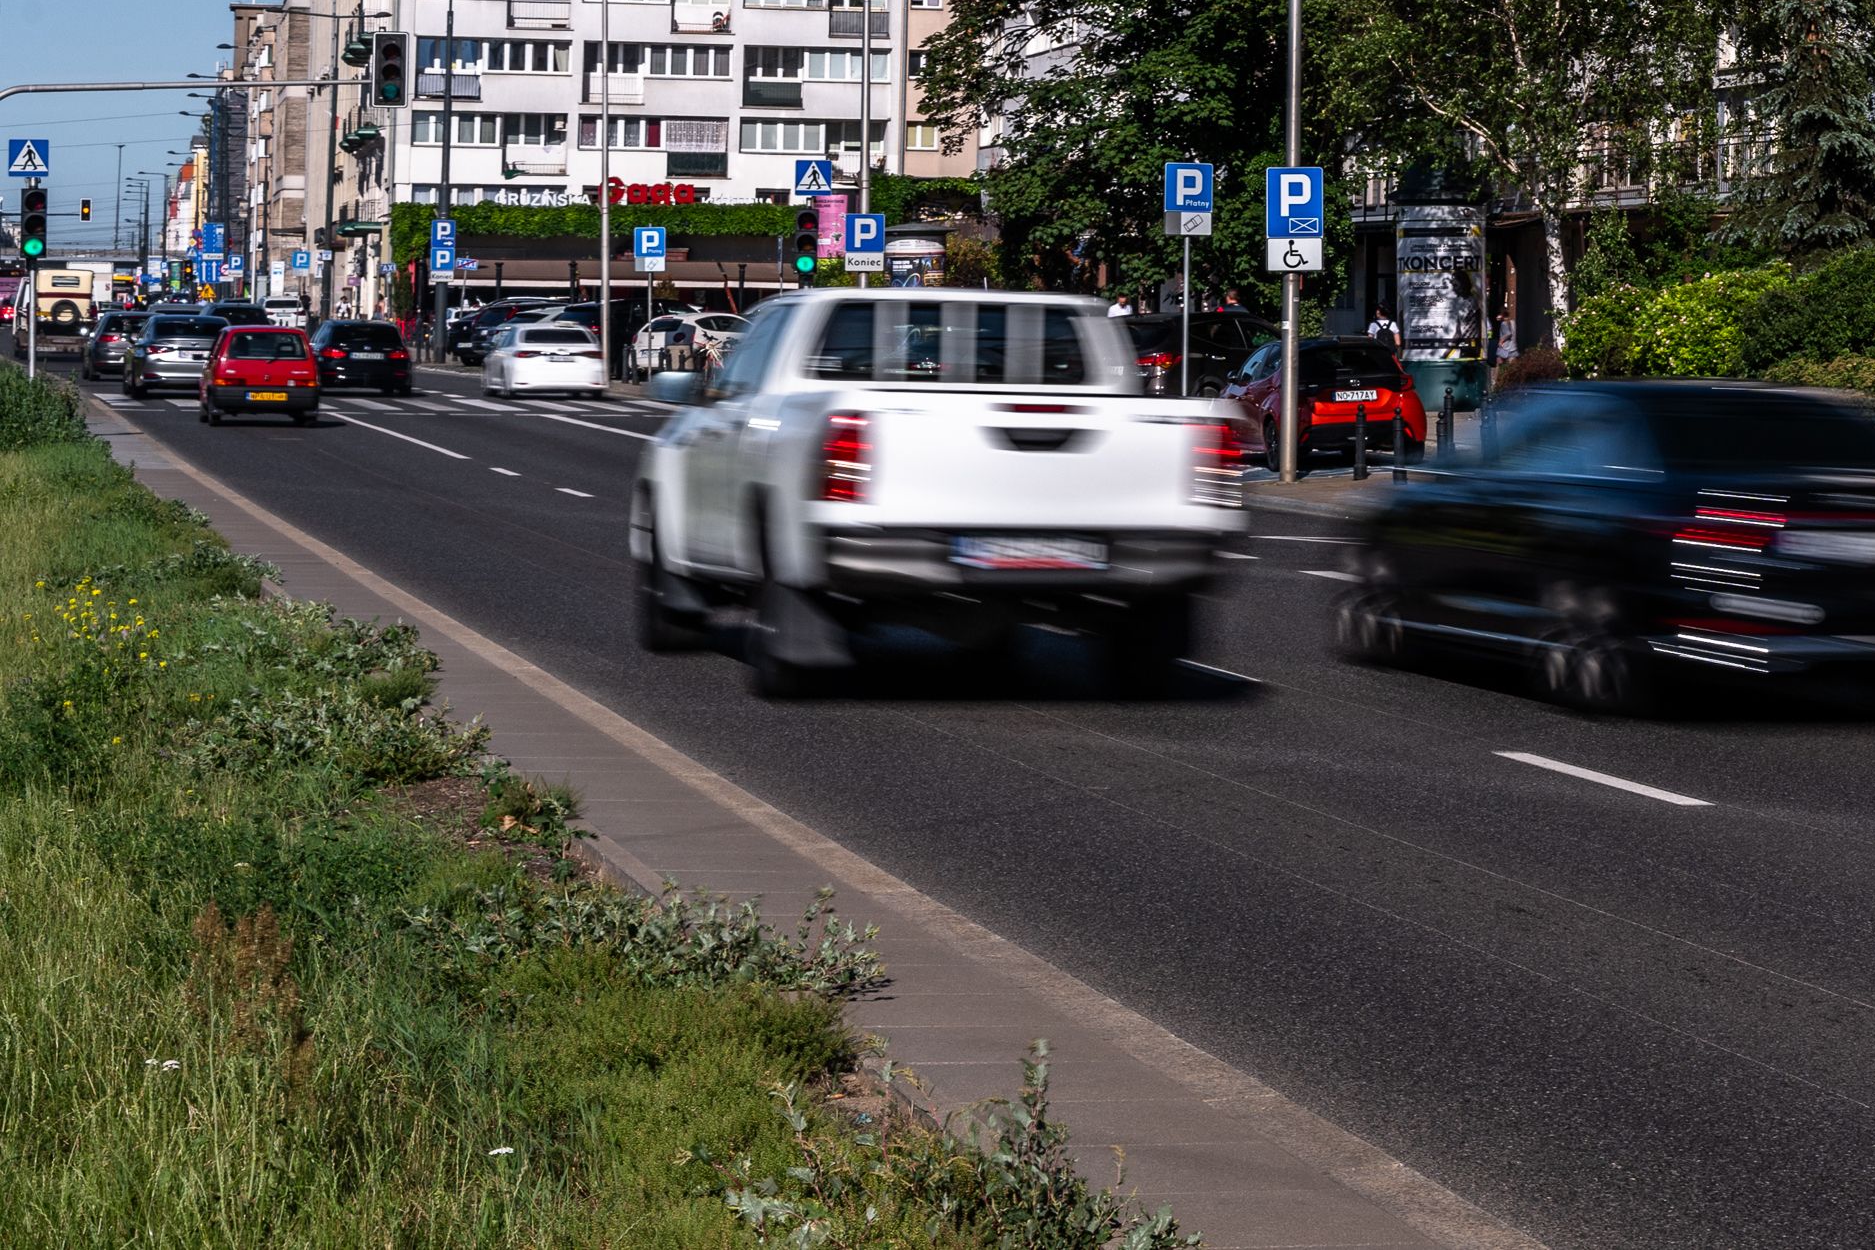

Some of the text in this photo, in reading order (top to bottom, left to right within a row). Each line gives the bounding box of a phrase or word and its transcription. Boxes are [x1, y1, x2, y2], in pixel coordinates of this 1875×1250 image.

[1177, 169, 1203, 205] P
[1280, 174, 1312, 217] P
[1185, 199, 1209, 209] Płatny
[437, 222, 451, 240] P
[854, 218, 876, 248] P
[642, 231, 659, 253] P
[436, 251, 450, 268] P
[848, 258, 881, 266] Koniec
